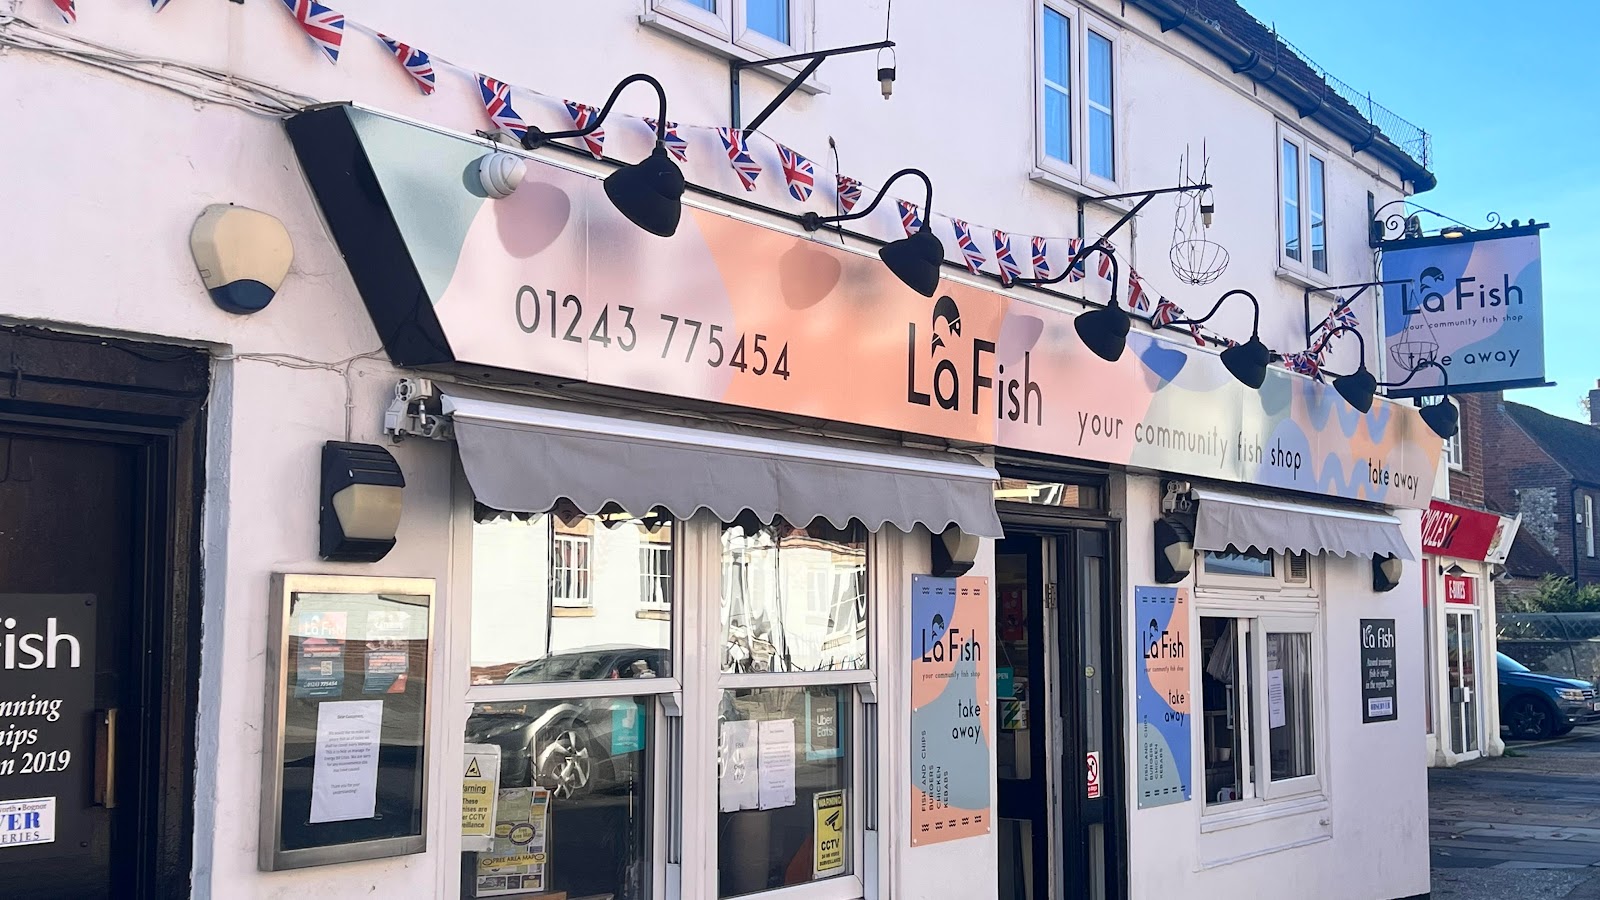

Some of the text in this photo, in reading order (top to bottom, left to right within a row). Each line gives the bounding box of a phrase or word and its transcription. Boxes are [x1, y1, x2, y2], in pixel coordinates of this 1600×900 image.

[1401, 274, 1524, 315] La Fish
[515, 285, 790, 381] 01243 775454
[1404, 314, 1524, 332] your community fish shop
[1409, 349, 1520, 369] take away
[908, 322, 1042, 426] La Fish
[1078, 411, 1302, 480] your community fish shop
[1368, 458, 1420, 499] take away
[0, 618, 80, 669] ish
[922, 628, 981, 663] La Fish
[1143, 630, 1184, 659] La Fish
[922, 673, 933, 681] your
[935, 670, 959, 680] community
[970, 670, 980, 679] shop
[1168, 689, 1185, 705] take
[958, 698, 981, 718] take
[816, 714, 833, 726] Uber
[1164, 711, 1185, 727] away
[816, 727, 833, 737] Eats
[951, 726, 981, 745] away
[20, 750, 71, 774] 2019
[22, 804, 47, 812] Bognor
[821, 838, 840, 851] CCTV
